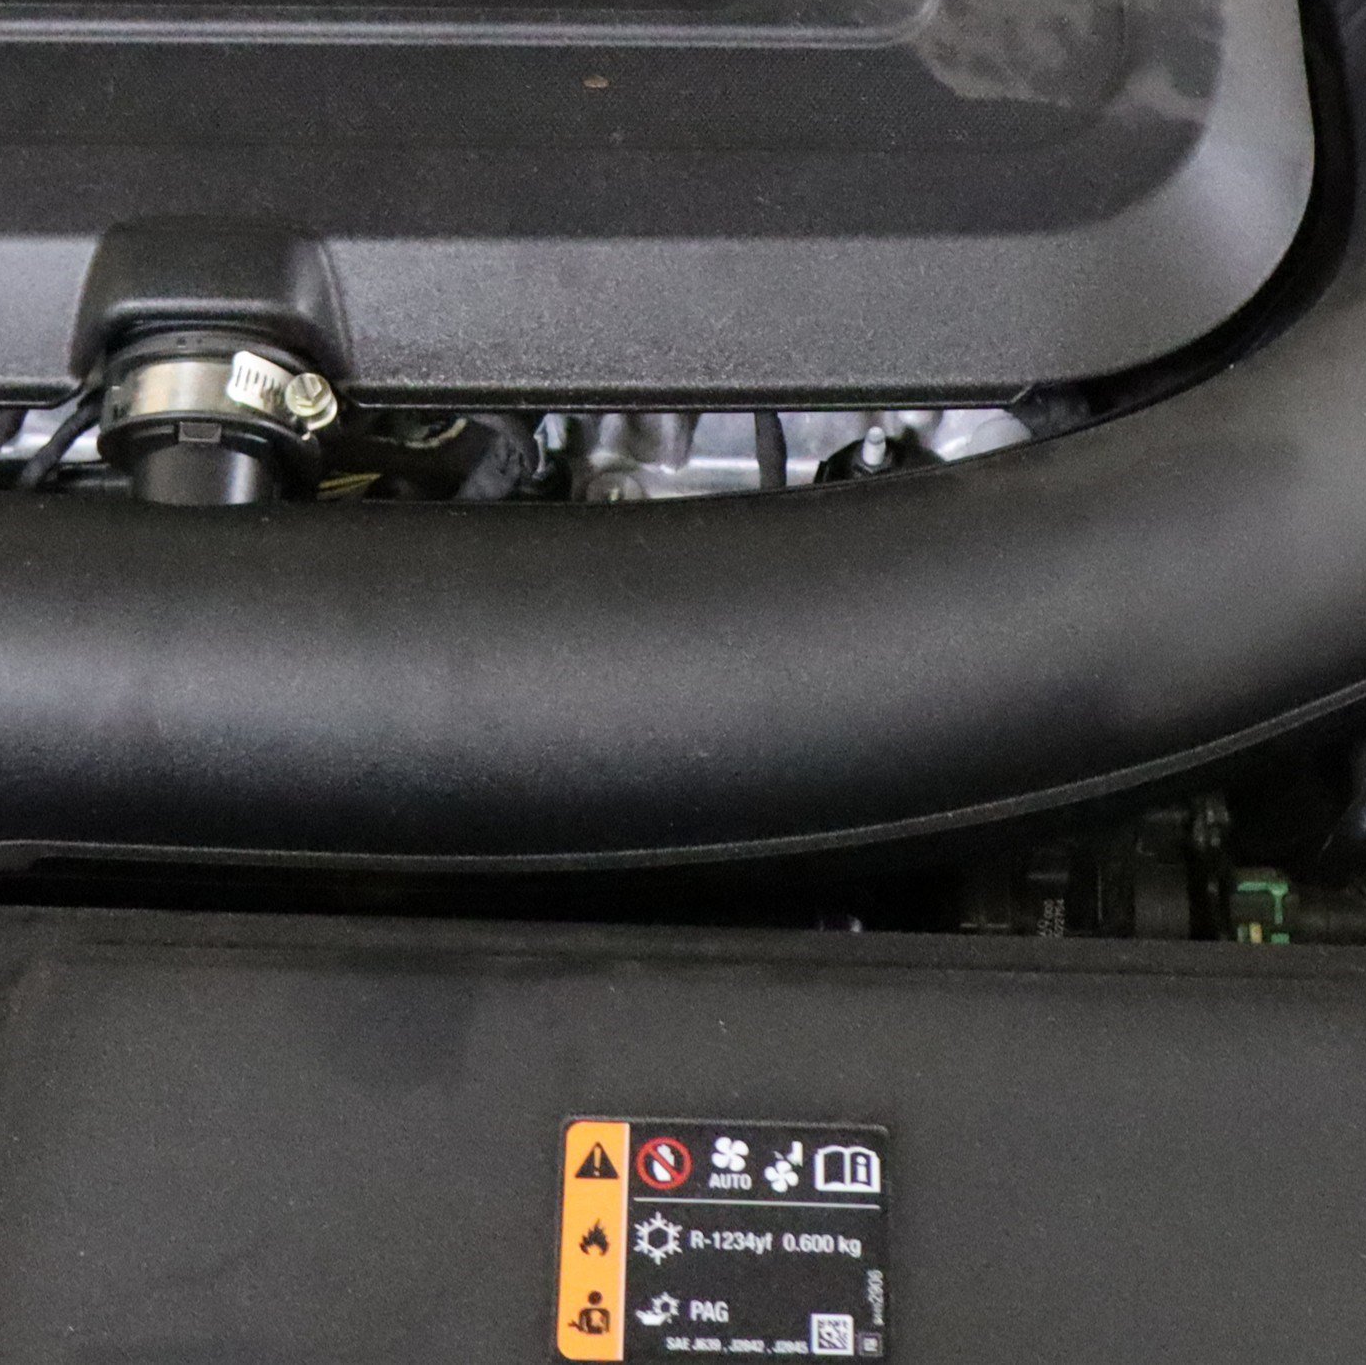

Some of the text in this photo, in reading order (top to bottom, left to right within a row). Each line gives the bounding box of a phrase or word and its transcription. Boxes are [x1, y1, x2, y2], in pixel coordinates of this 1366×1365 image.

[709, 1173, 751, 1190] AUTO
[691, 1233, 862, 1258] R-1234yf 0.600 kg
[690, 1300, 729, 1323] PAG
